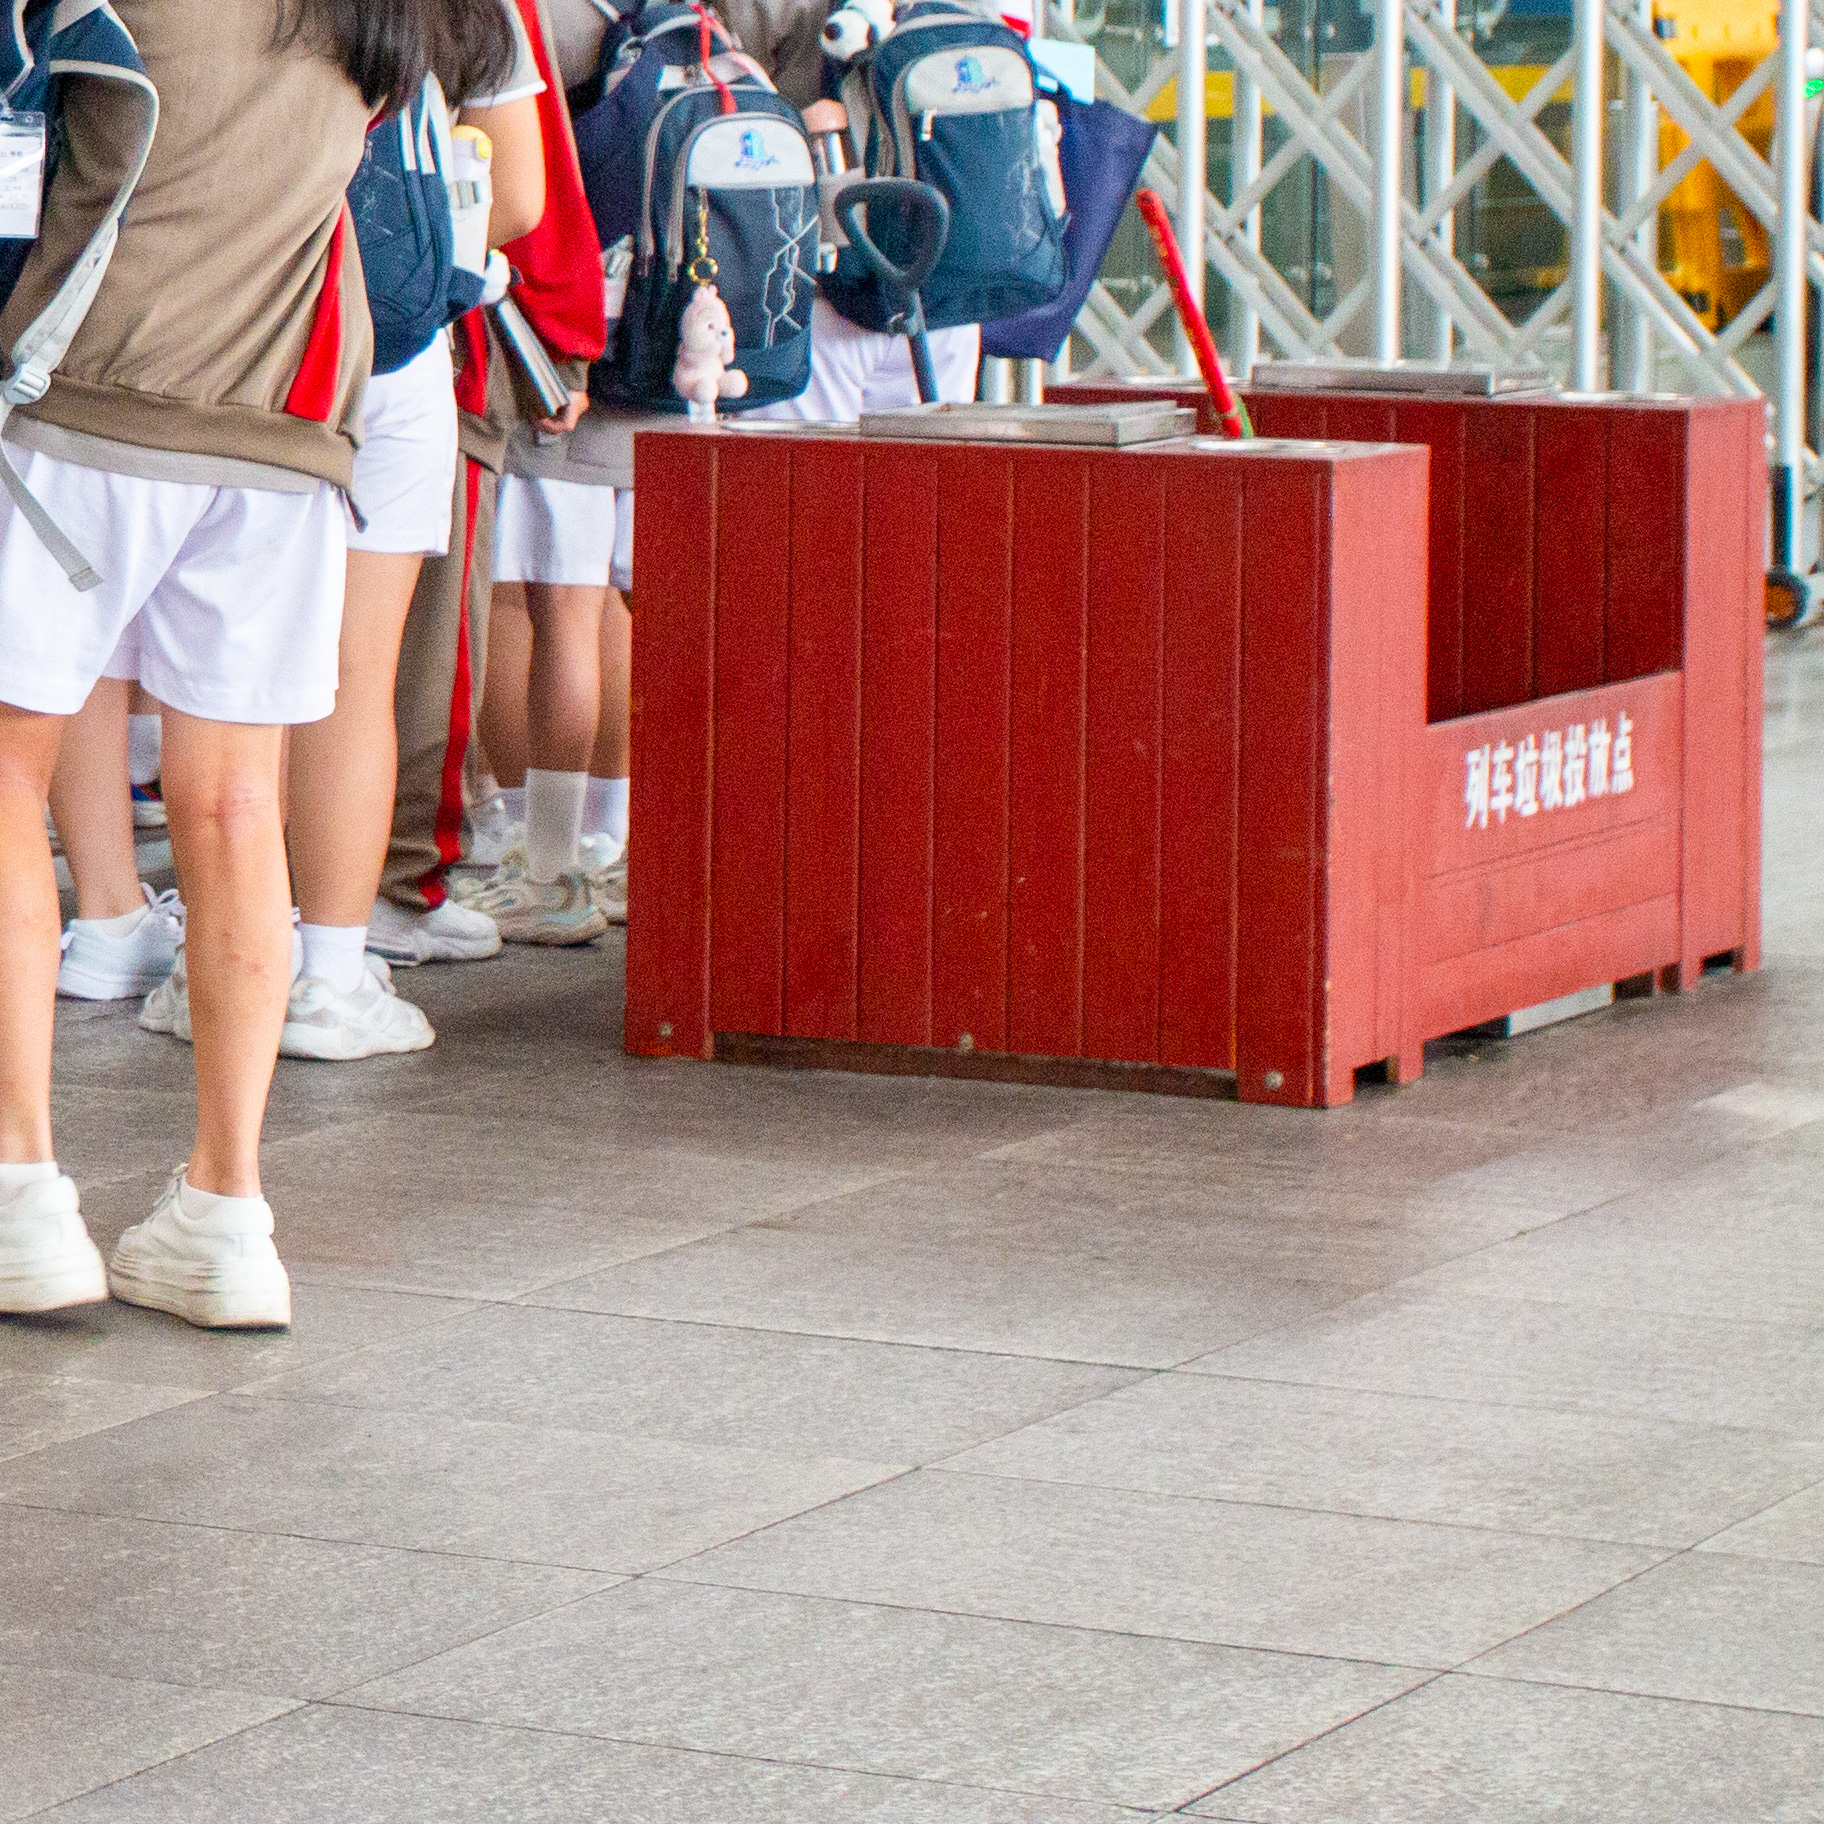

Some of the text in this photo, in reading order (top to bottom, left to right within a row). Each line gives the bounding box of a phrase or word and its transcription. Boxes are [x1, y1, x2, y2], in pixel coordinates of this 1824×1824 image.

[1464, 711, 1634, 829] 列车垃圾投放点
